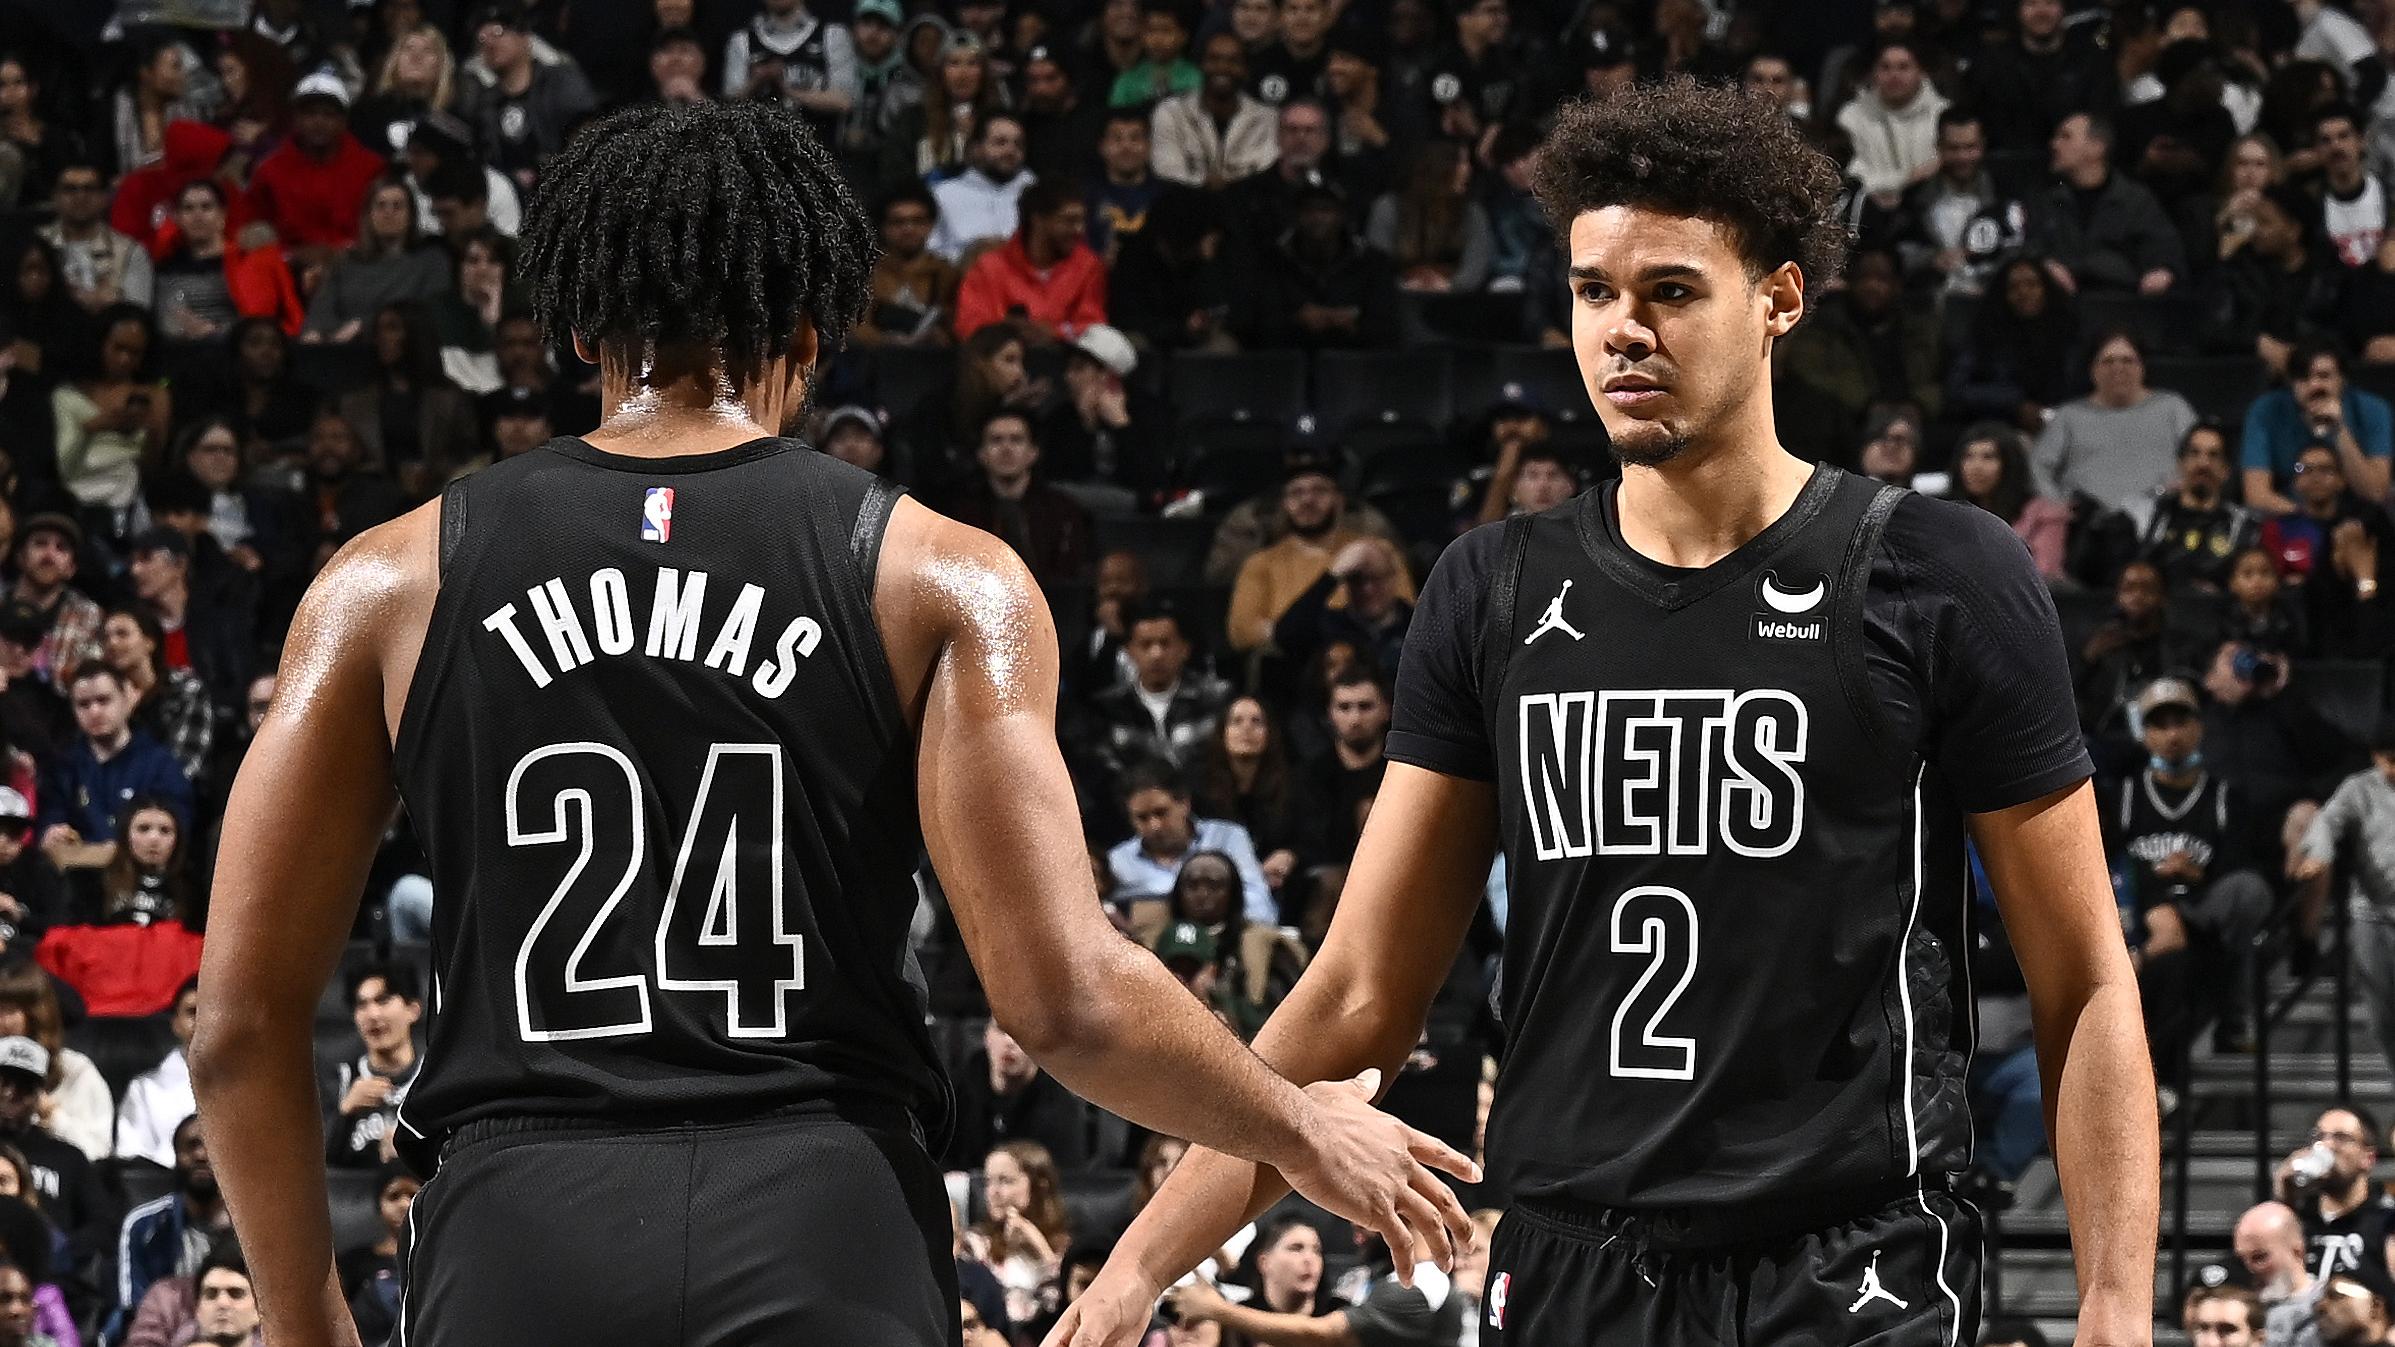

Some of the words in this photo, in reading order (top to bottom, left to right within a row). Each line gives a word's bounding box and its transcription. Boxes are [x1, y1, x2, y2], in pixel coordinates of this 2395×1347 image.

[481, 566, 822, 699] THOMAS
[1758, 620, 1820, 640] Webull
[1518, 688, 1809, 862] NETS
[505, 741, 805, 1042] 24
[1609, 885, 1699, 1081] 2
